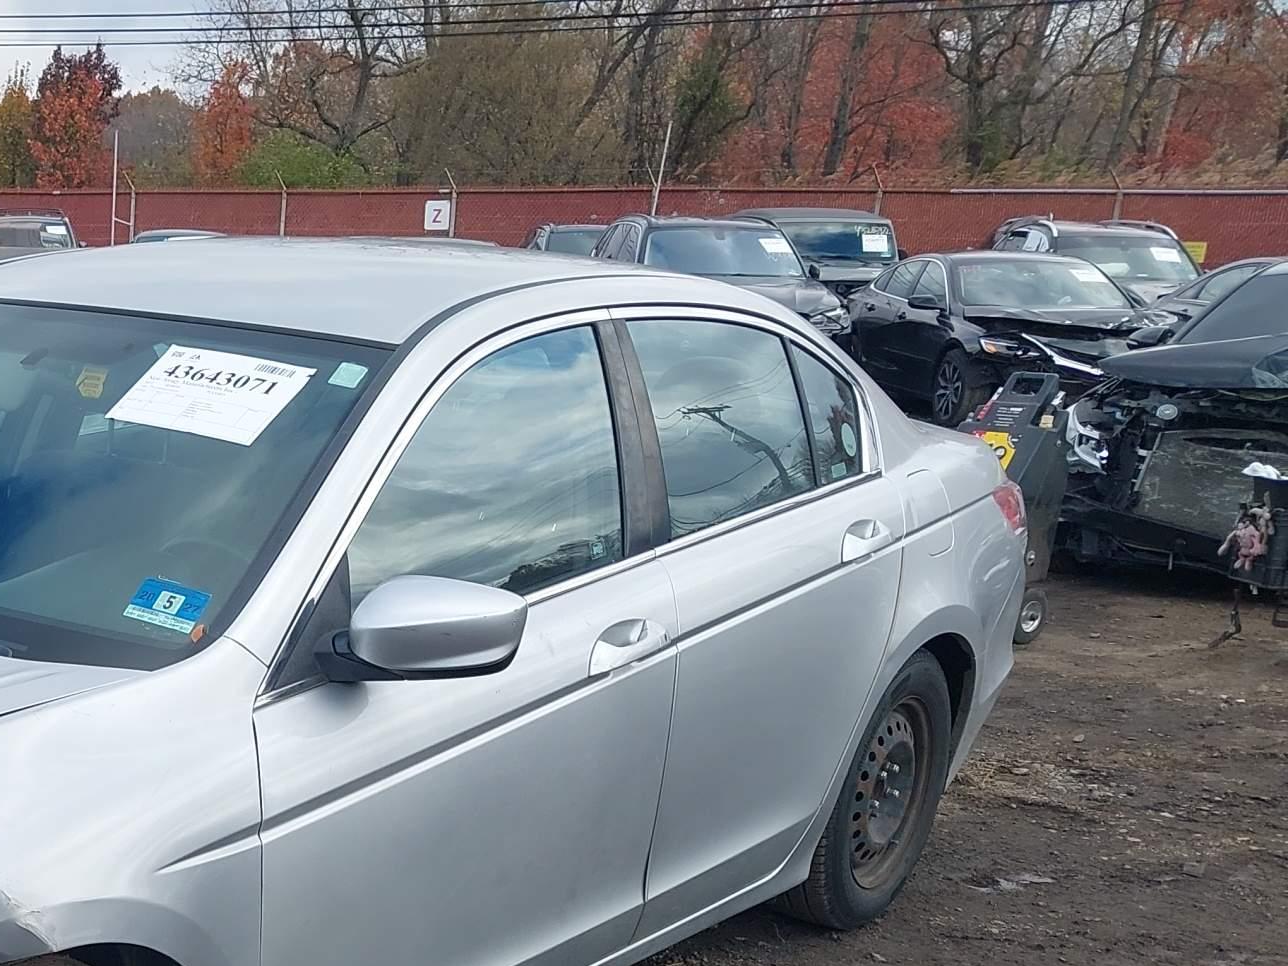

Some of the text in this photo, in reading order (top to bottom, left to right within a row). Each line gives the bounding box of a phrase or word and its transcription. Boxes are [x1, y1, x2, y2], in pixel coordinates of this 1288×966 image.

[431, 208, 443, 224] Z
[163, 364, 279, 395] 43643071
[162, 595, 177, 610] 5
